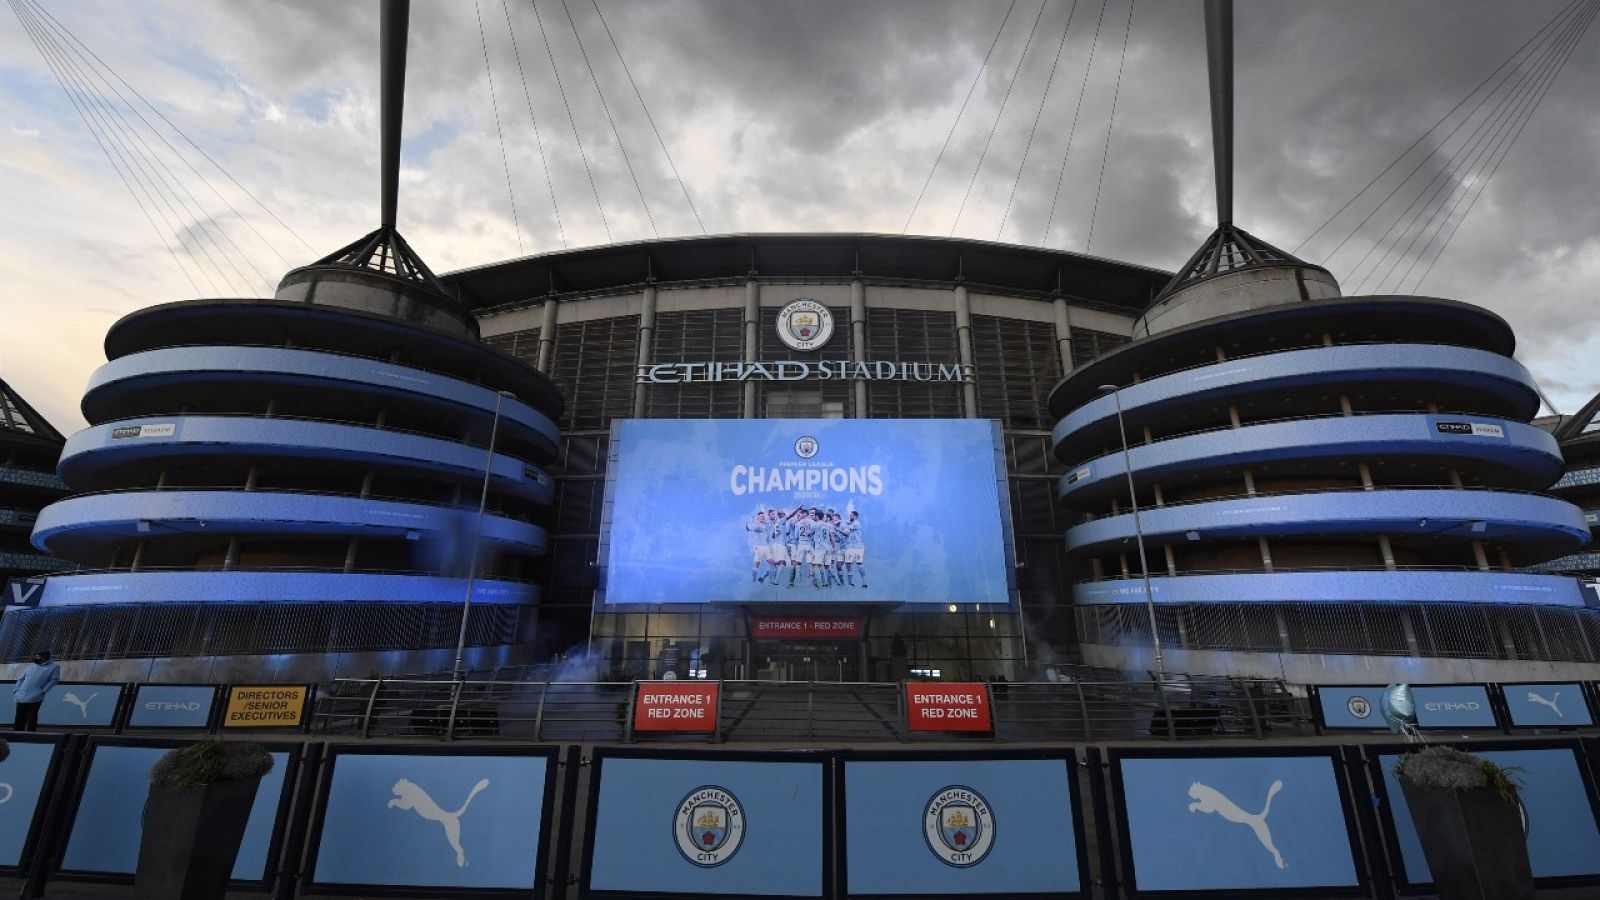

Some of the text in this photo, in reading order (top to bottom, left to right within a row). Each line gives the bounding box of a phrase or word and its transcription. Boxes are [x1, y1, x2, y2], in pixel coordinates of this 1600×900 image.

[781, 302, 828, 318] MANCHESTER
[649, 360, 963, 383] ETIHAD STADIUM
[730, 464, 883, 496] CHAMPIONS
[759, 622, 801, 630] ENTRANCE
[803, 622, 808, 630] 1
[814, 622, 832, 630] RED
[834, 622, 855, 630] ZONE
[237, 691, 298, 700] DIRECTORS
[643, 695, 711, 704] ENTRANCE 1
[914, 695, 981, 704] ENTRANCE 1
[145, 702, 200, 711] ETIHAD
[244, 701, 288, 710] /SENIOR
[1424, 703, 1479, 711] ETIHAD
[231, 711, 296, 720] EXECUTIVES
[648, 709, 704, 718] RED ZONE
[921, 709, 978, 718] RED ZONE
[682, 791, 738, 816] MANCHESTER
[930, 791, 987, 816] MANCHESTER
[697, 853, 718, 861] CITY
[951, 853, 972, 861] CITY
